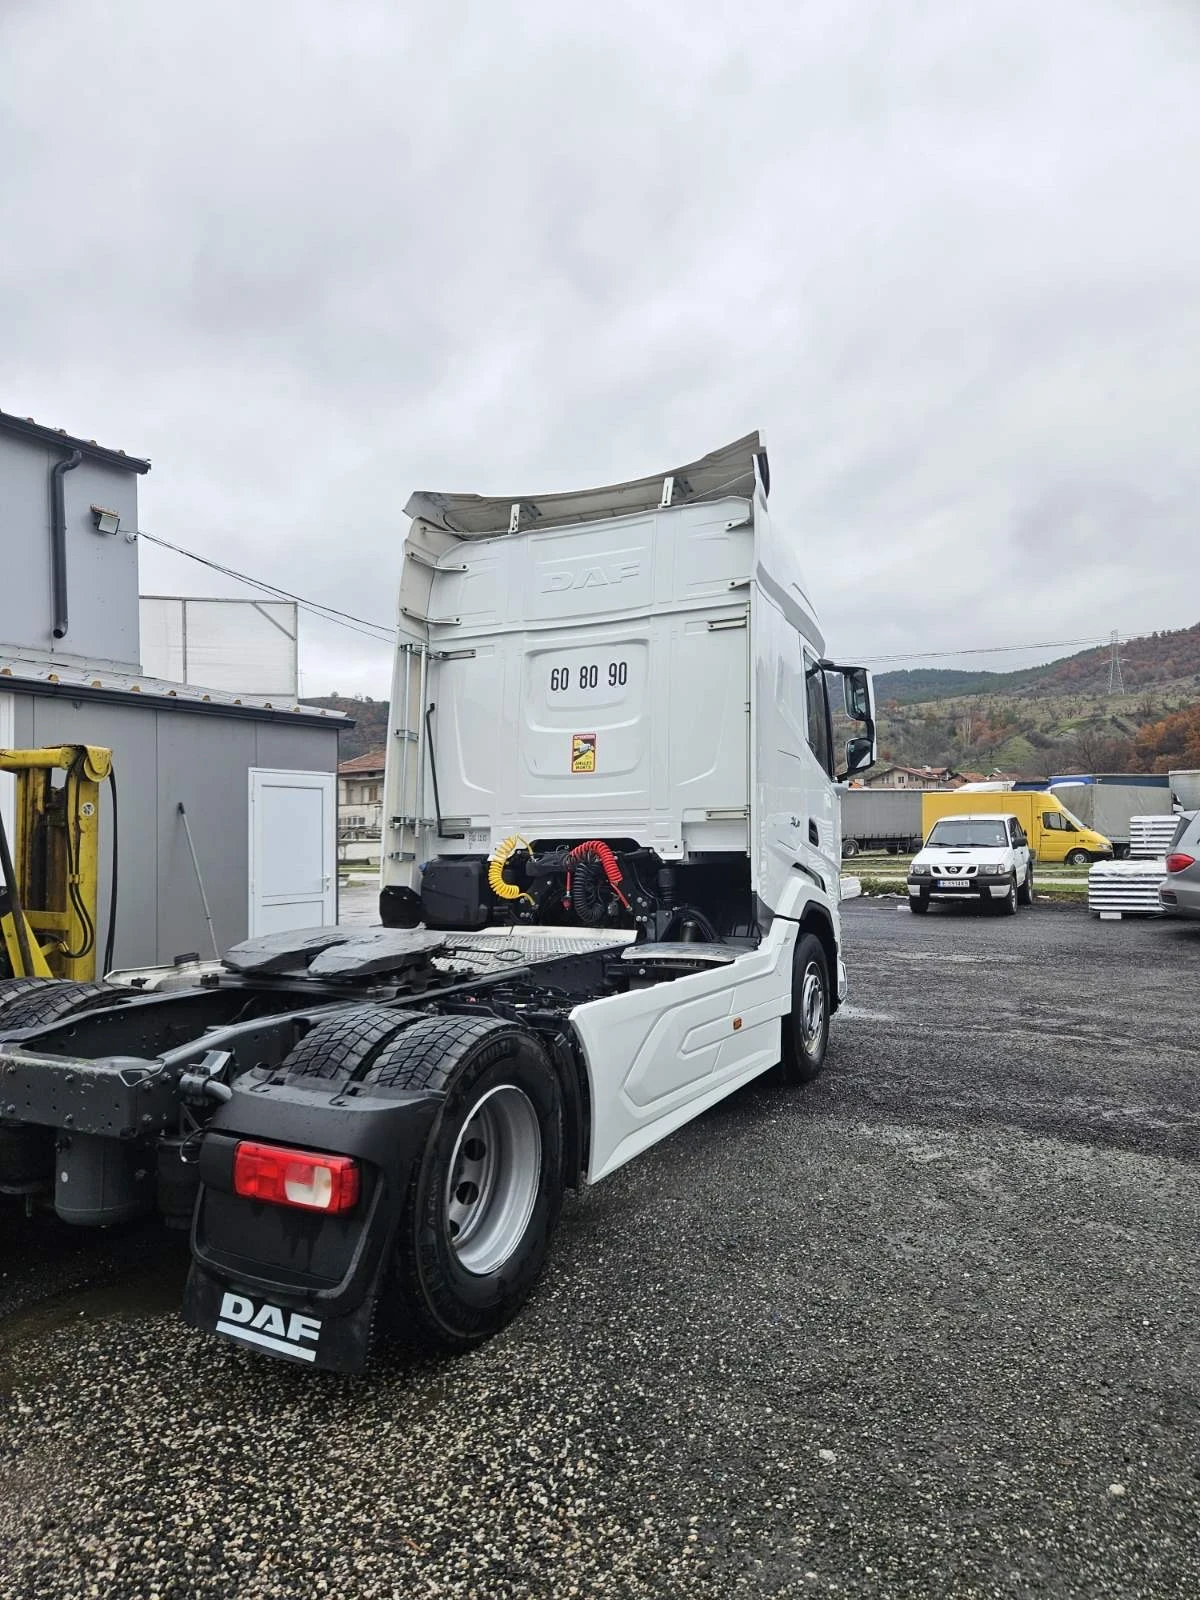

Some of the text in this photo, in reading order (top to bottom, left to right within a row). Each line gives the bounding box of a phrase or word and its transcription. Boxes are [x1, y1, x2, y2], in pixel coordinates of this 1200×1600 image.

[540, 561, 640, 593] DAF
[551, 661, 627, 691] 60 80 90
[219, 1292, 322, 1341] DAF
